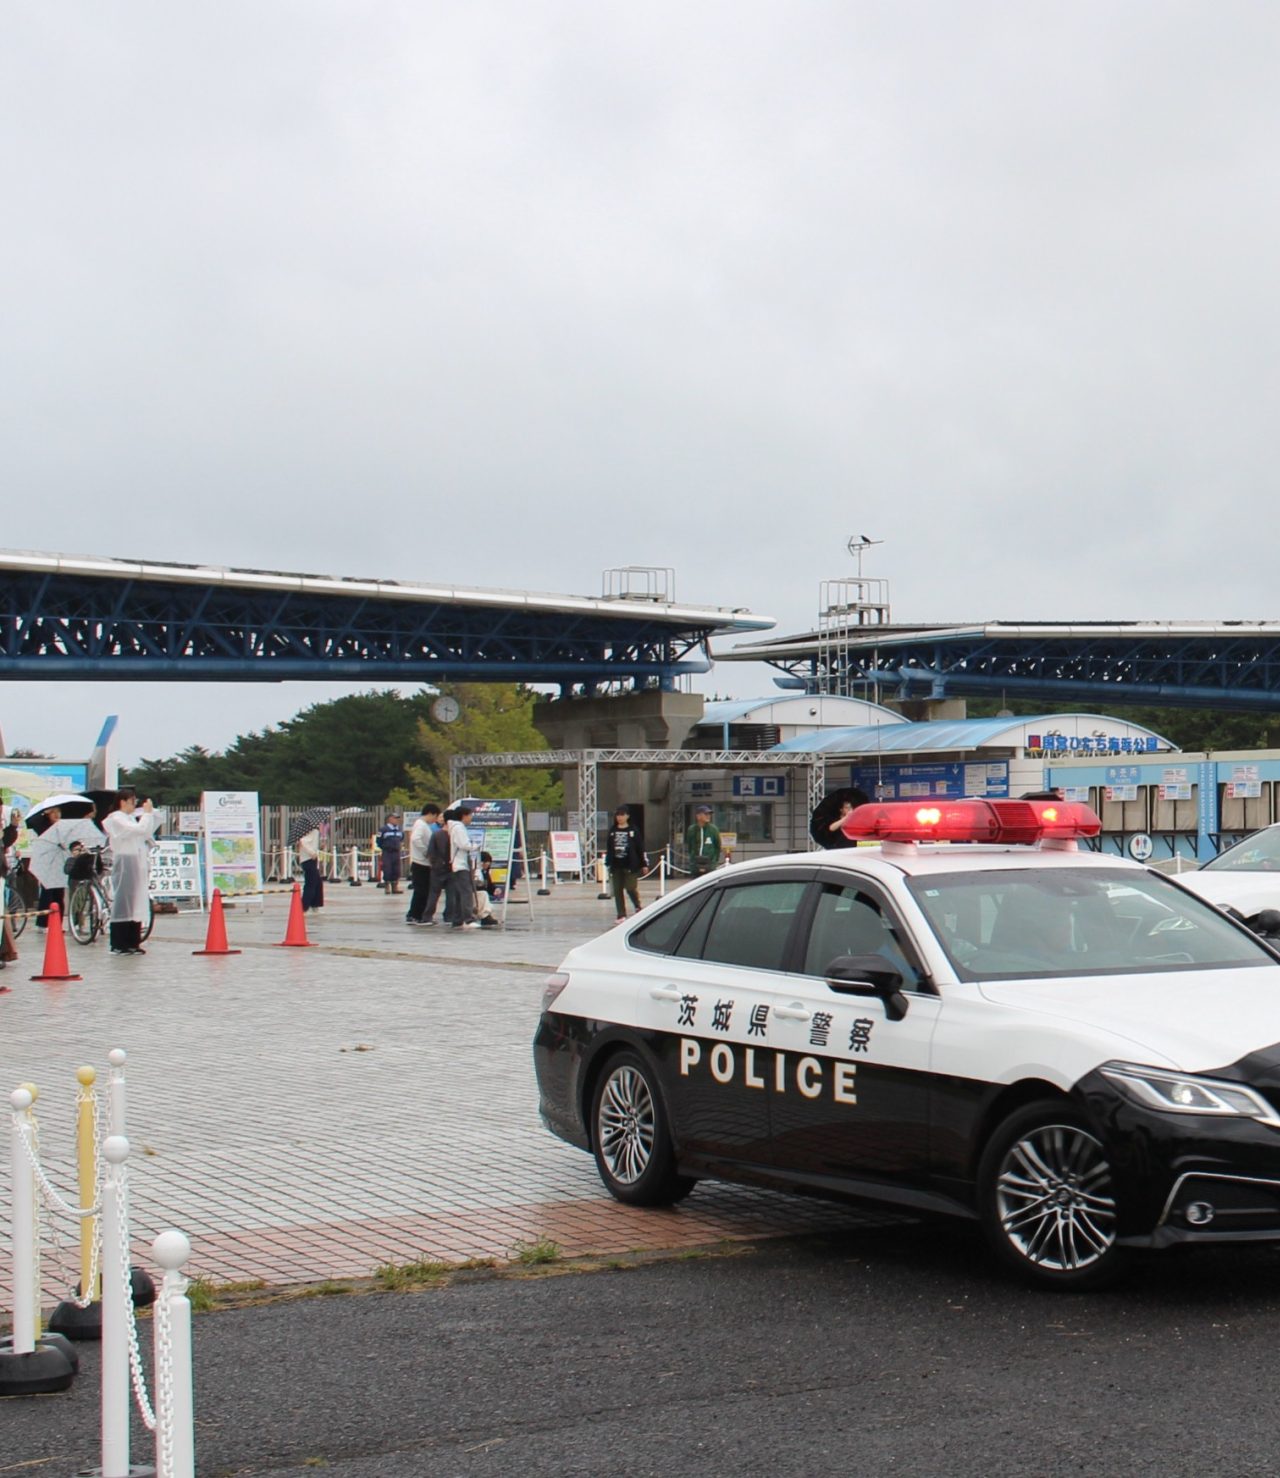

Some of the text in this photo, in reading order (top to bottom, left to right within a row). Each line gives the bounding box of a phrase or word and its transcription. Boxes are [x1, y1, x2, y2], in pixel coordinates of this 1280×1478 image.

[677, 994, 874, 1053] 茨城県警察
[680, 1037, 858, 1105] POLICE
